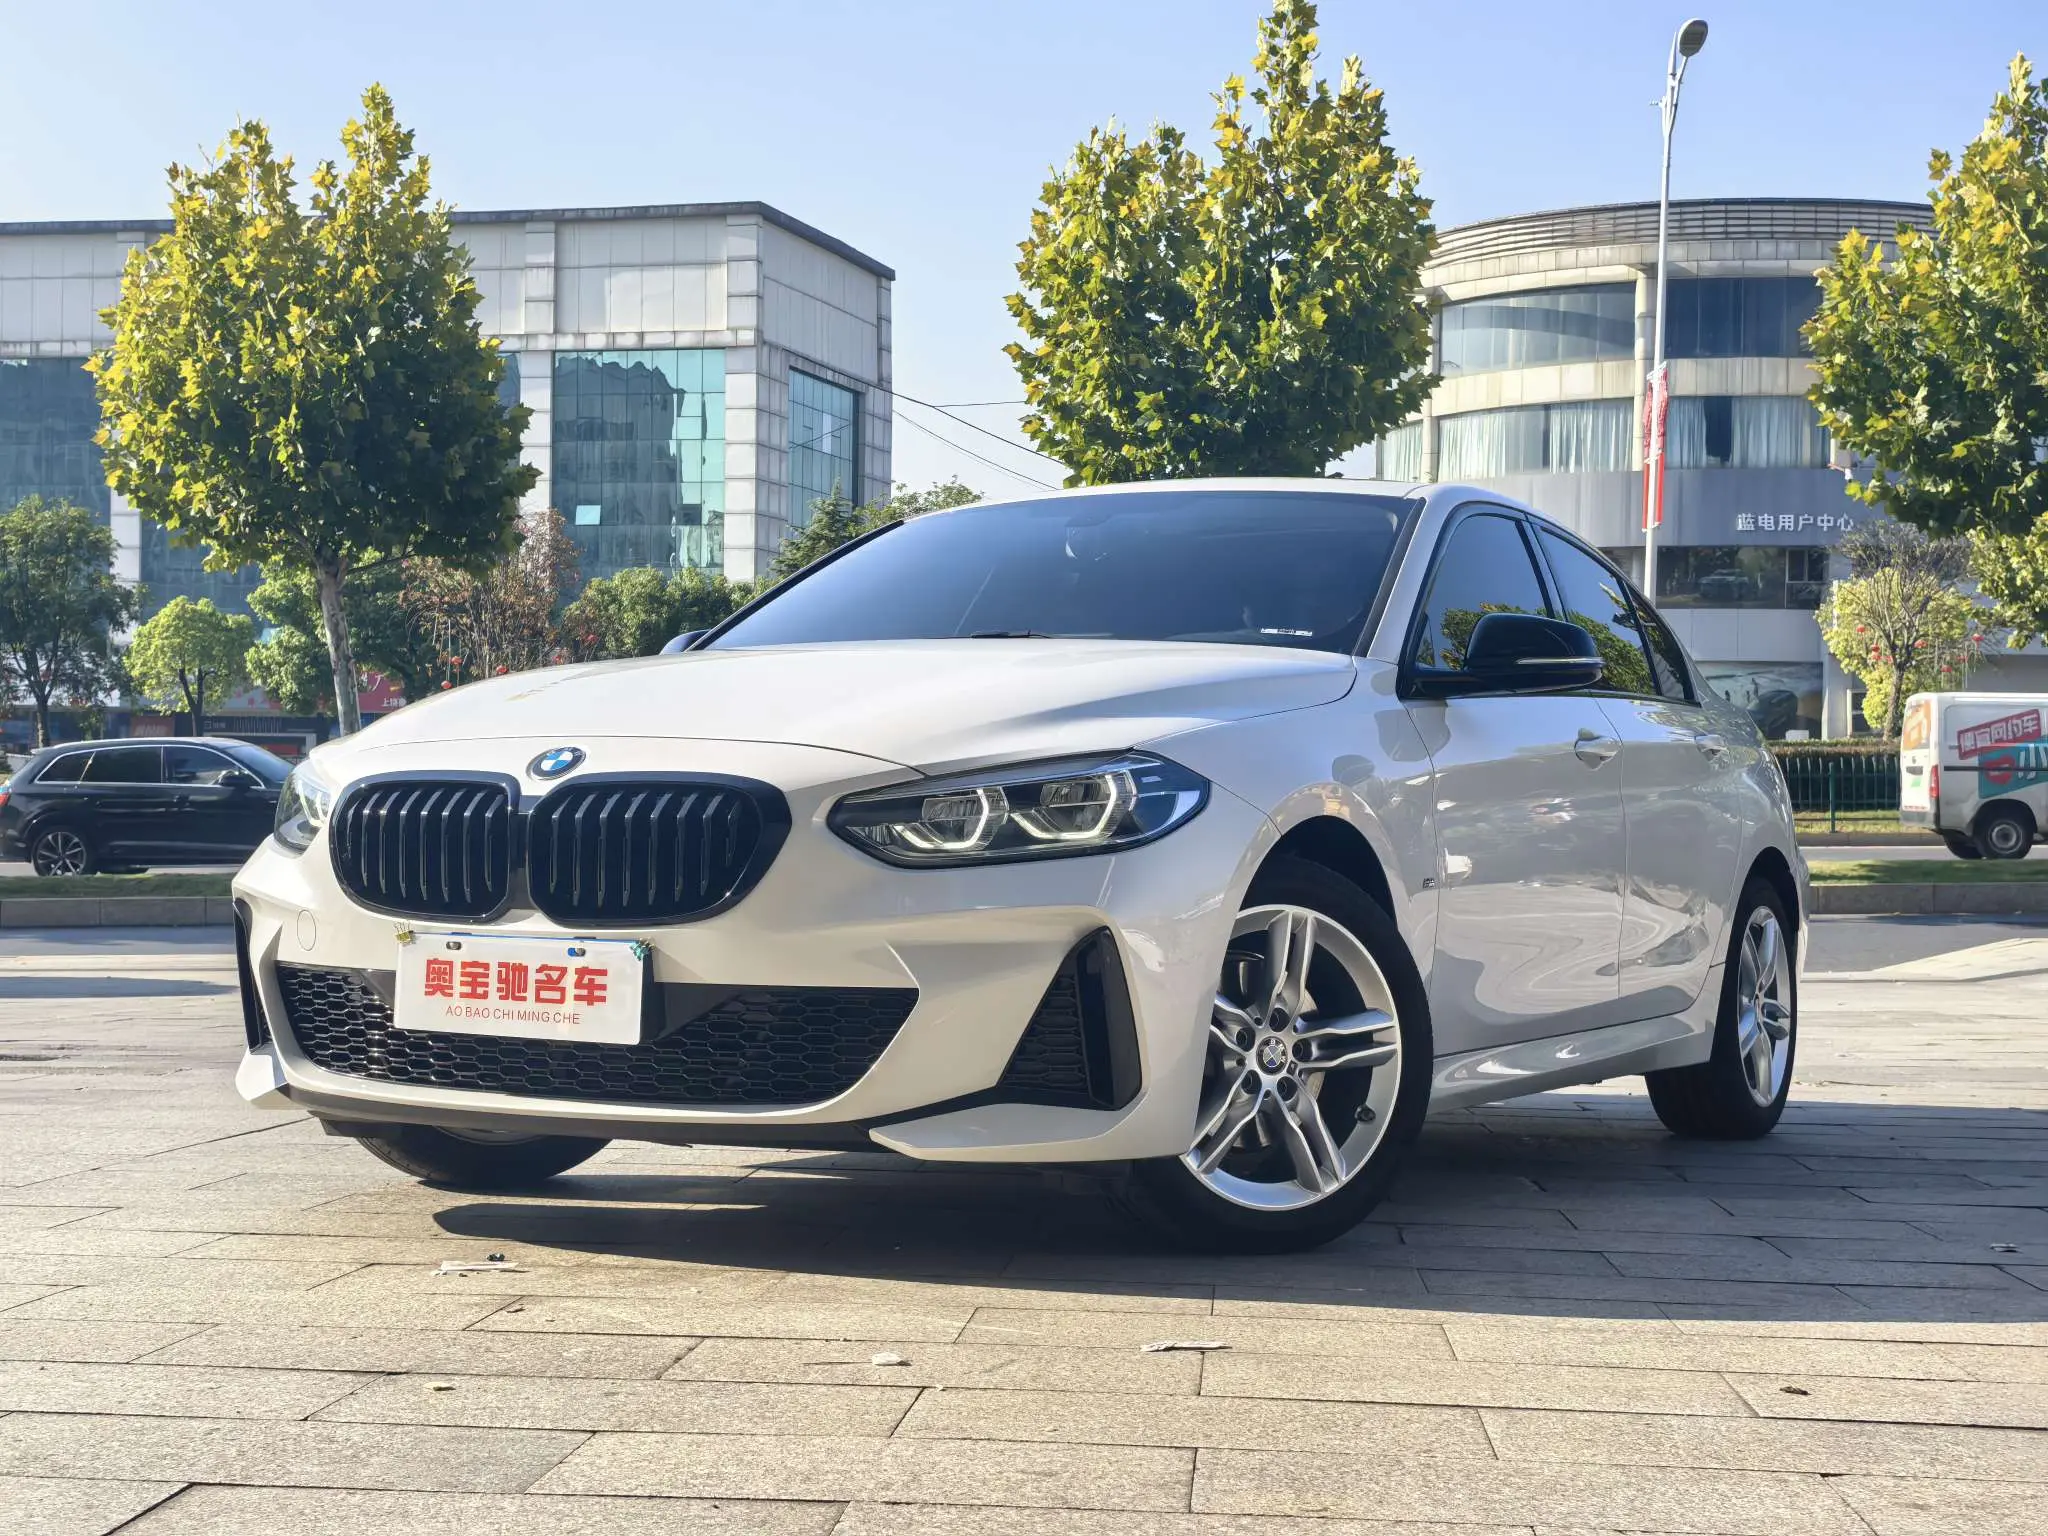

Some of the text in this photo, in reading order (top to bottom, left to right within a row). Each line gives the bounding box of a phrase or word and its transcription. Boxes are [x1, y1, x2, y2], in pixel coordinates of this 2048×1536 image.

[1736, 513, 1854, 532] 蓝电用户中心
[424, 957, 608, 1006] 奥宝驰名车
[445, 1005, 580, 1025] AO BAO CHI MING CHE
